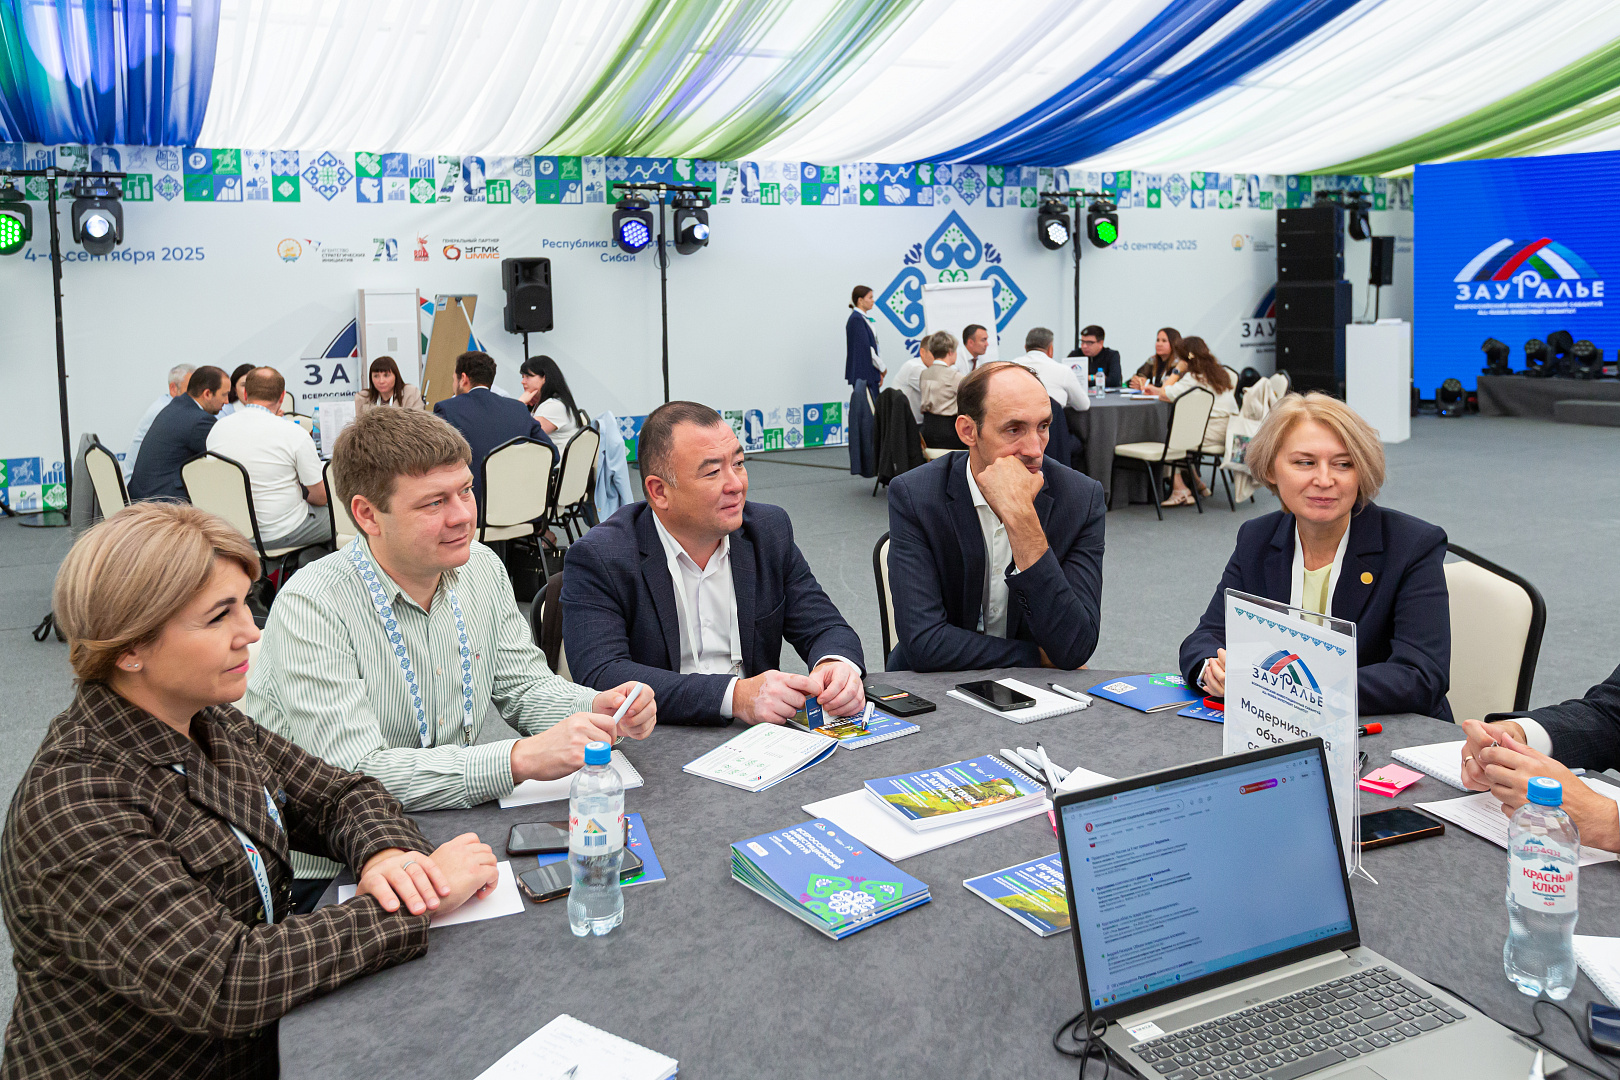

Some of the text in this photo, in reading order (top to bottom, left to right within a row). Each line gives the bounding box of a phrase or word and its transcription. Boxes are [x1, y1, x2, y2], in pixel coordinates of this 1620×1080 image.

[542, 238, 608, 250] Республика
[1176, 240, 1198, 250] 2025
[162, 247, 205, 261] 2025
[1456, 270, 1604, 300] ЗАУРАЛЬЕ
[1252, 668, 1323, 708] ЗАУРАЛЬЕ
[1523, 867, 1574, 883] КРАСНЫЙ
[1532, 881, 1566, 894] КЛЮЧ
